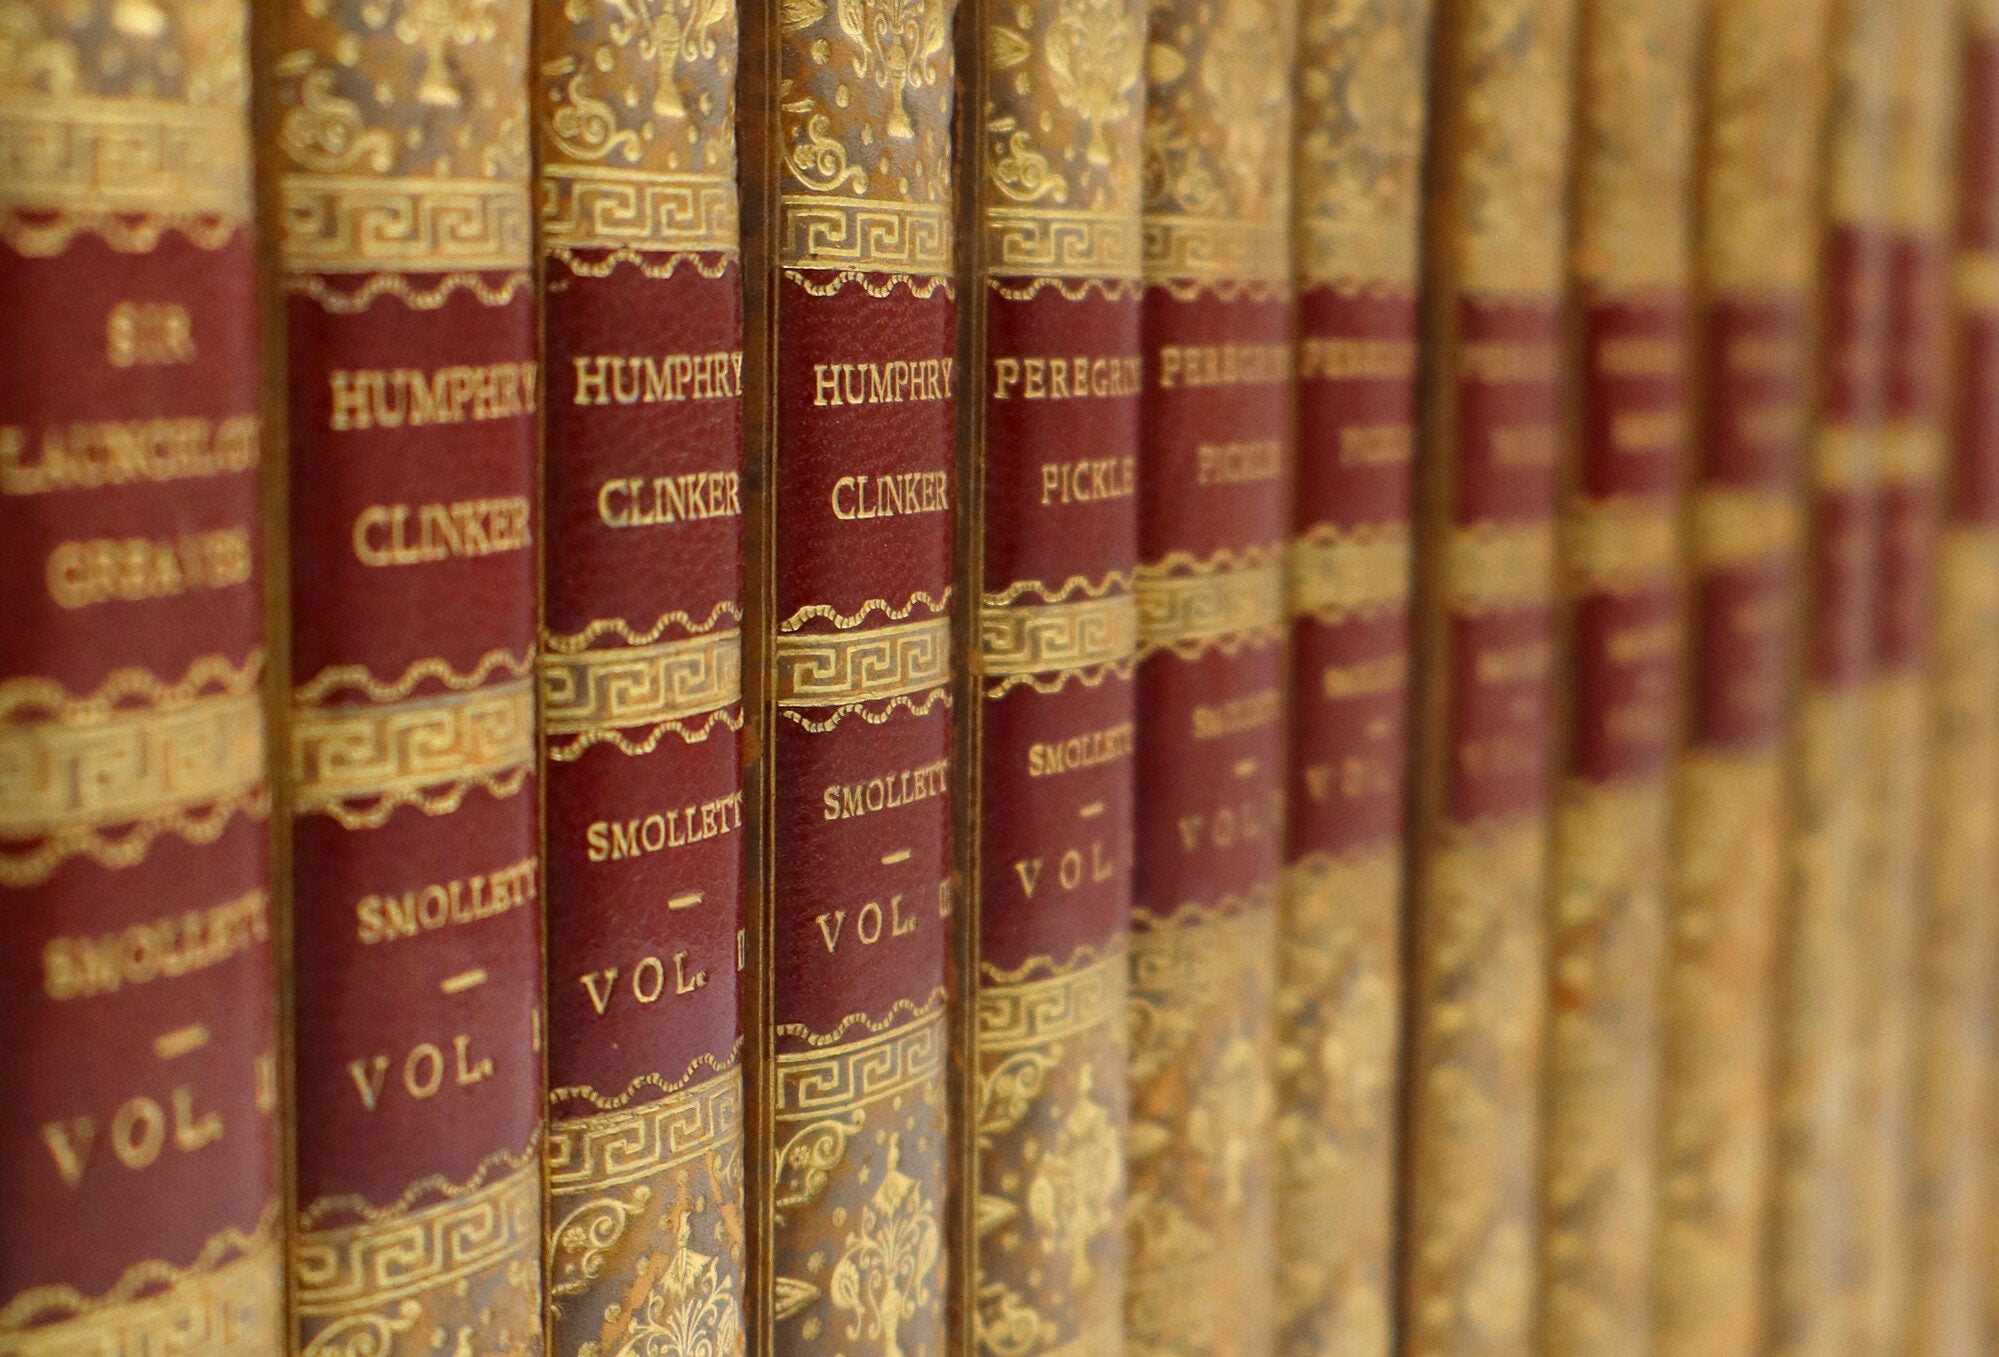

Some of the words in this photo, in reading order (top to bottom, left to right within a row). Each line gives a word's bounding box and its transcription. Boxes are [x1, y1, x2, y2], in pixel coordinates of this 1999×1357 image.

[331, 360, 537, 430] HUMPHRY
[572, 350, 743, 405] HUMPHRY
[813, 357, 953, 406] HUMPHRY
[597, 471, 742, 528] CLINKER
[831, 471, 949, 520] CLINKER
[1040, 456, 1136, 505] PICKLE
[352, 496, 532, 567] CLINKER
[823, 758, 948, 821] SMOLLETT
[587, 790, 743, 862] SMOLLETT
[356, 857, 537, 944] SMOLLETT
